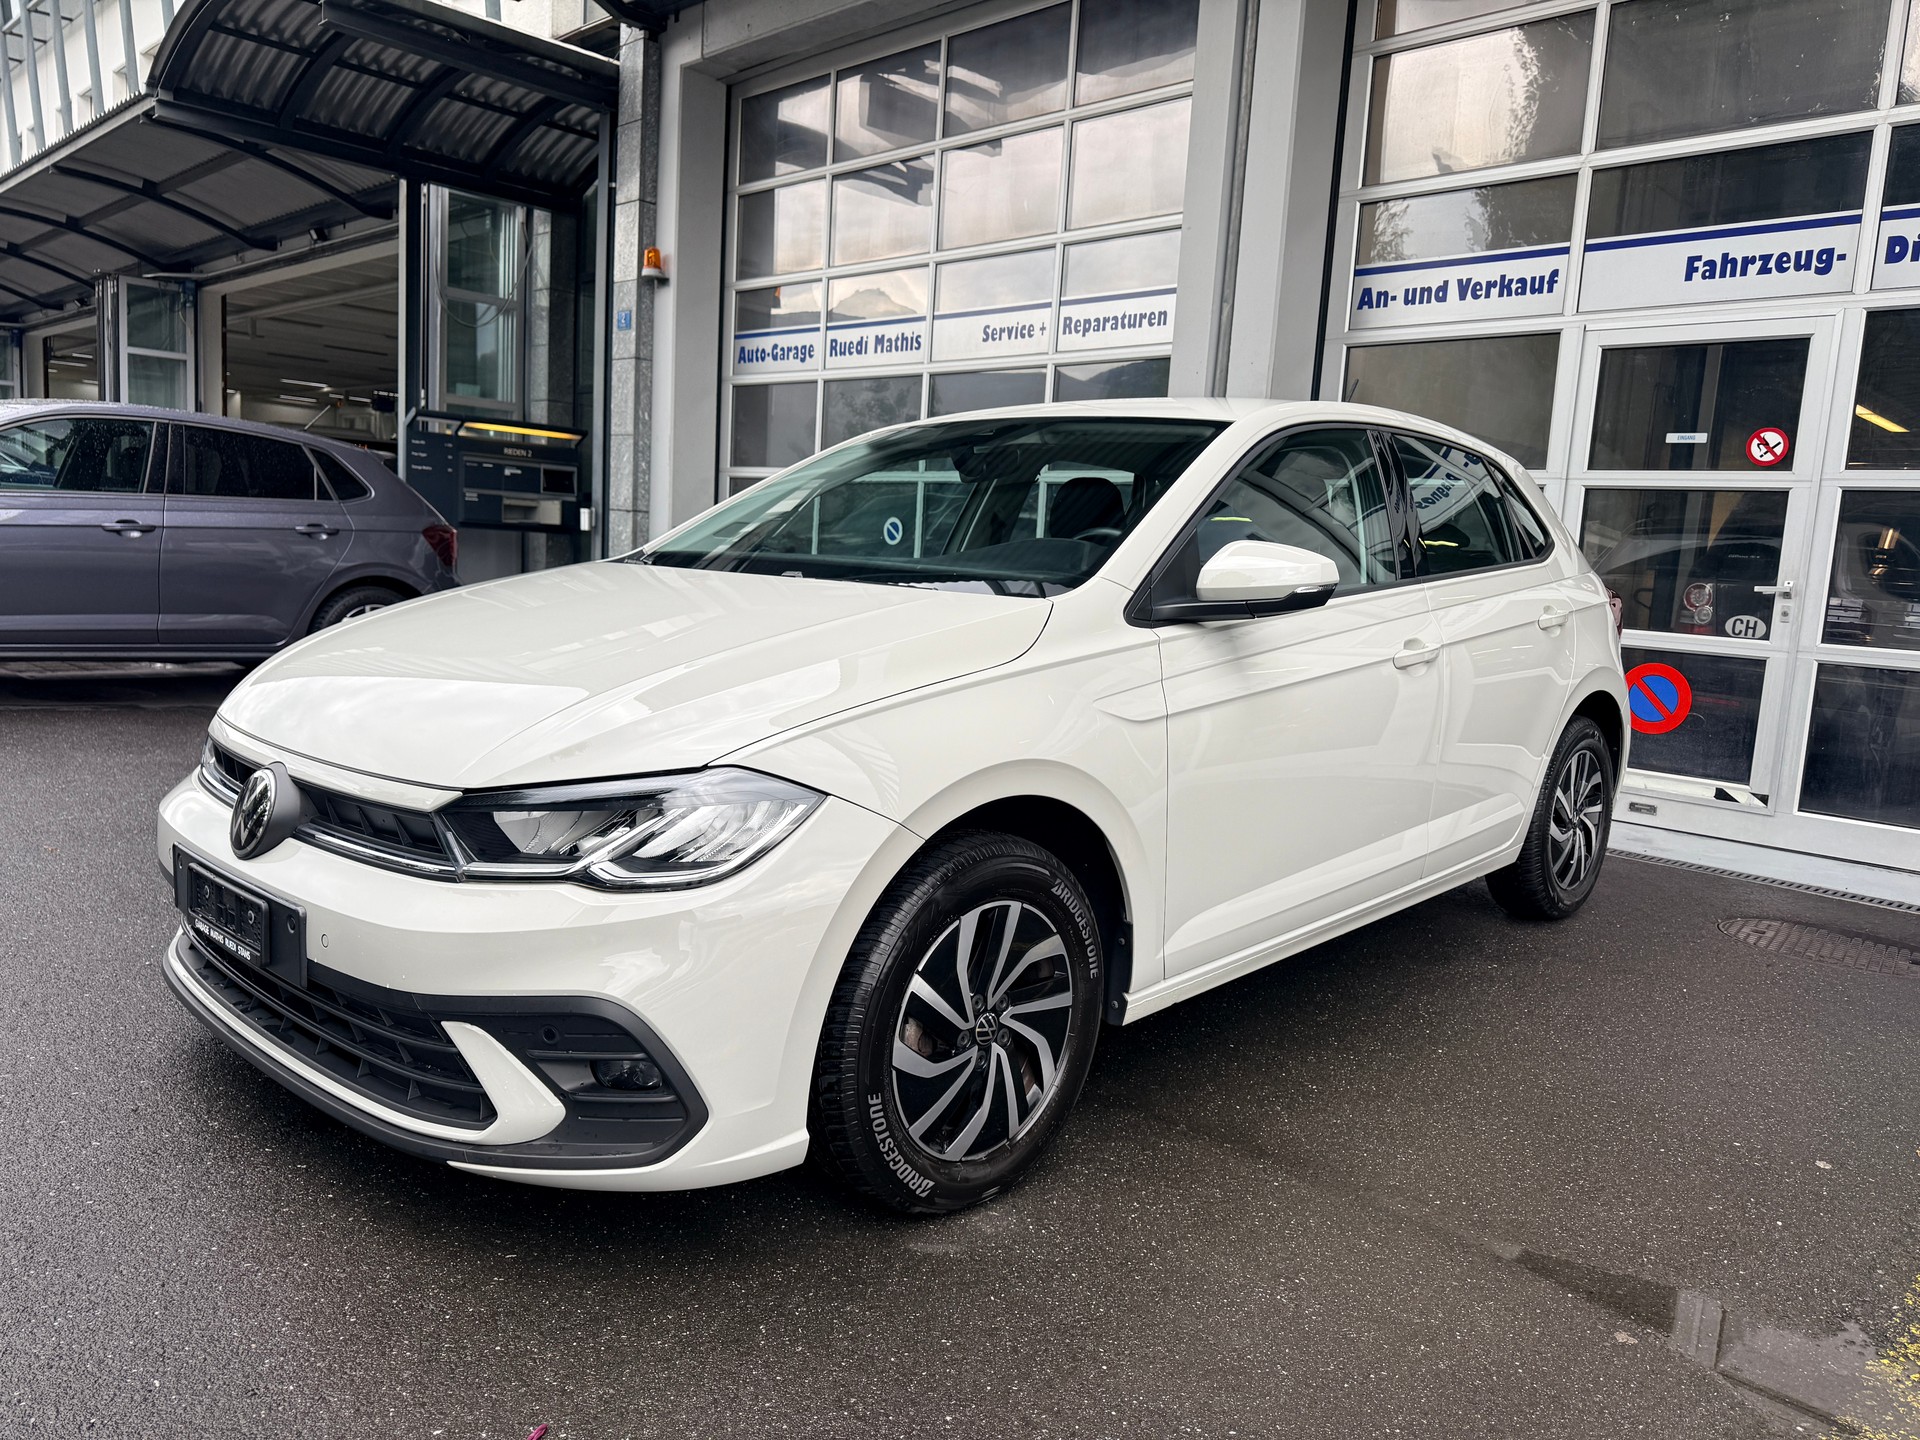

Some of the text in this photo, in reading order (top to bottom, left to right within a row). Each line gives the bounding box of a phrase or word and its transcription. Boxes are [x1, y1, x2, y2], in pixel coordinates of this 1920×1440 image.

[1684, 246, 1847, 282] Fahrzeug-
[1356, 268, 1560, 310] An- und Verkauf
[982, 323, 1047, 342] Service +
[1062, 309, 1168, 338] Reparaturen
[737, 342, 815, 365] Auto-Garage
[829, 332, 922, 357] Ruedi Mathis
[503, 447, 533, 458] RIEDEN 2
[1731, 617, 1758, 638] CH
[194, 918, 210, 935] GARAGE
[1051, 878, 1099, 979] BRIDGESTONE
[867, 1092, 936, 1198] BRIDGESTONE
